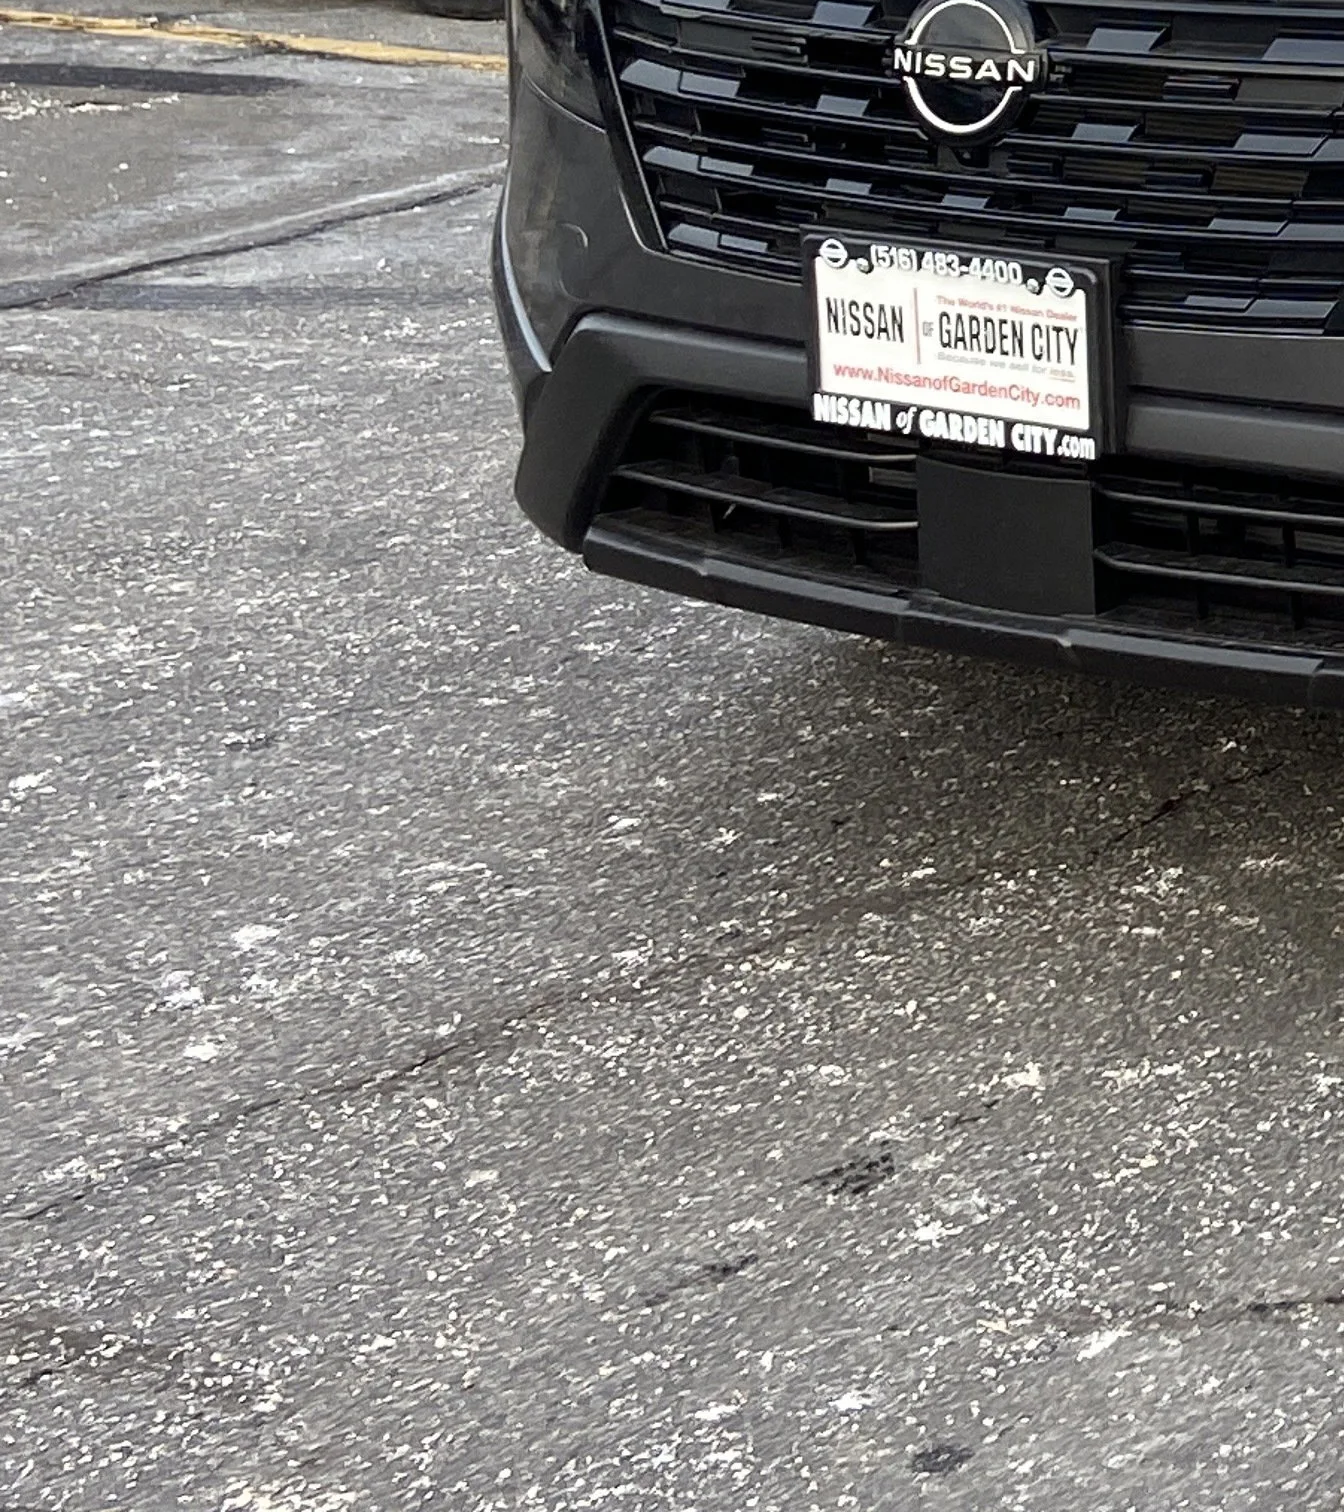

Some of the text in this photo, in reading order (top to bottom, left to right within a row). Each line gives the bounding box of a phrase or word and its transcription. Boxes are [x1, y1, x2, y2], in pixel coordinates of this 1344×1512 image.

[893, 47, 1036, 83] NISSAN
[870, 243, 1023, 286] (516) 483-4400
[936, 294, 956, 307] The
[957, 297, 994, 312] World's
[1046, 308, 1078, 322] Dealer
[825, 296, 905, 343] NISSAN
[938, 310, 1025, 359] GARDEN
[1031, 321, 1079, 366] CITY
[936, 351, 987, 366] Because
[833, 362, 1081, 410] www.NissanofGardenCity.com
[812, 392, 892, 432] NISSAN
[895, 405, 919, 435] of
[918, 408, 1006, 449] GARDEN
